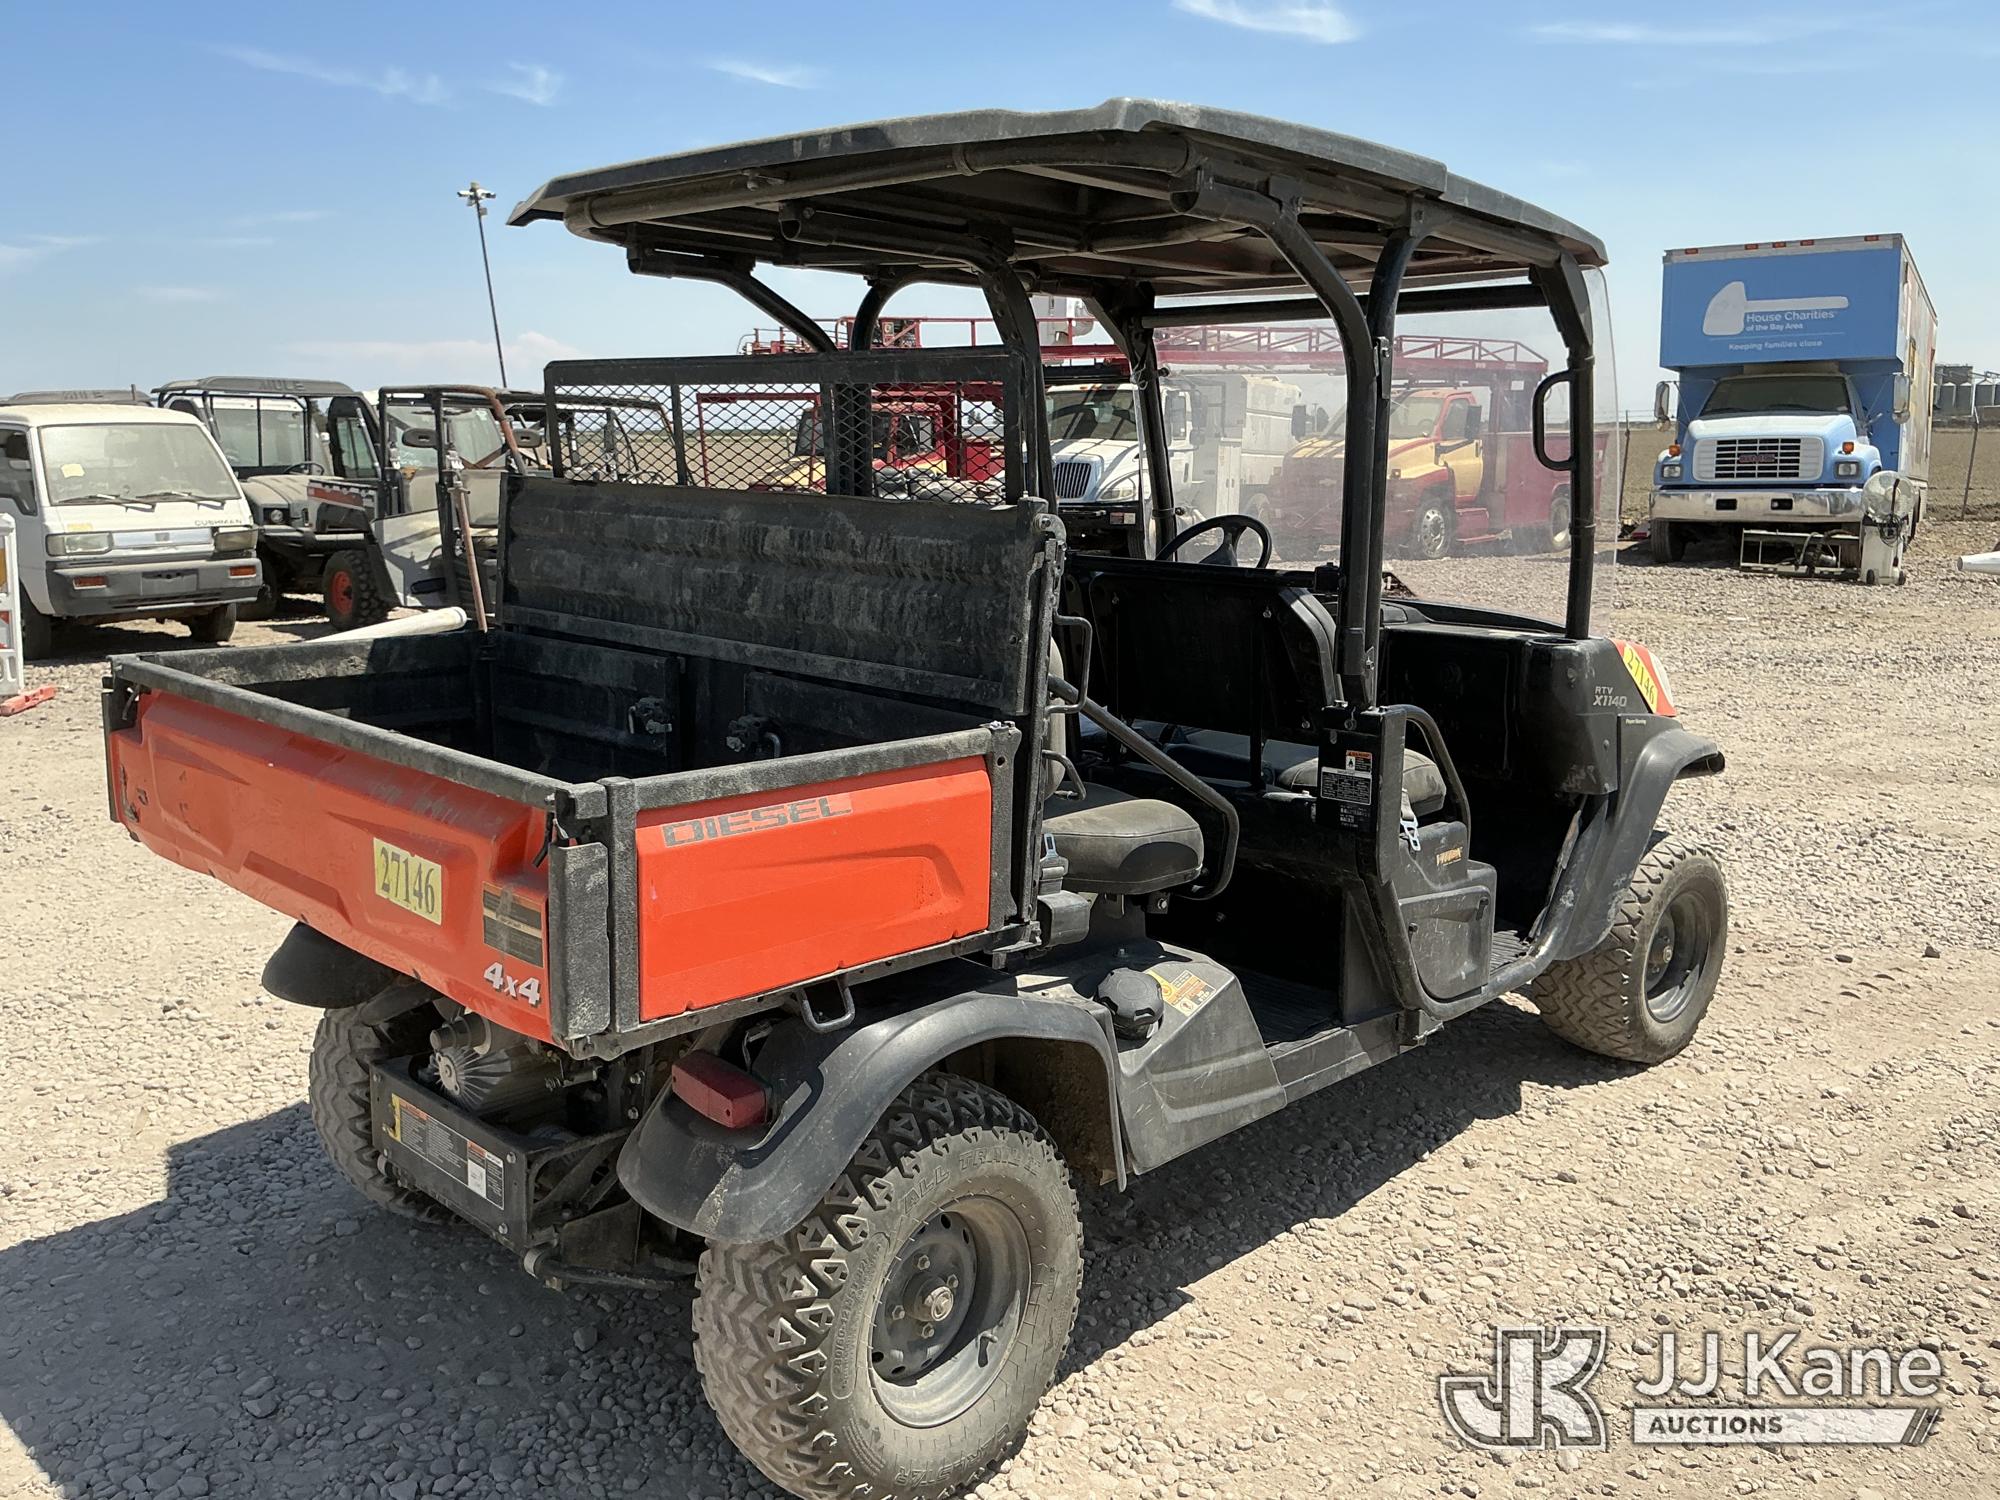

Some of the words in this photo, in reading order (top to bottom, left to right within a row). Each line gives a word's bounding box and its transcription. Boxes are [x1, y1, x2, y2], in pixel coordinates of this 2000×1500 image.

[1746, 313, 1782, 323] House
[1784, 310, 1835, 321] Charities
[1769, 323, 1784, 332] Bay
[1784, 322, 1803, 330] Area
[1728, 342, 1762, 351] Keeping
[1764, 341, 1797, 349] families
[1799, 339, 1823, 347] close
[1627, 647, 1655, 705] 27146
[1594, 686, 1614, 694] RTV
[1592, 695, 1628, 707] X1140
[664, 796, 852, 848] DIESEL
[379, 846, 436, 916] 27146
[483, 962, 541, 1006] 4x4
